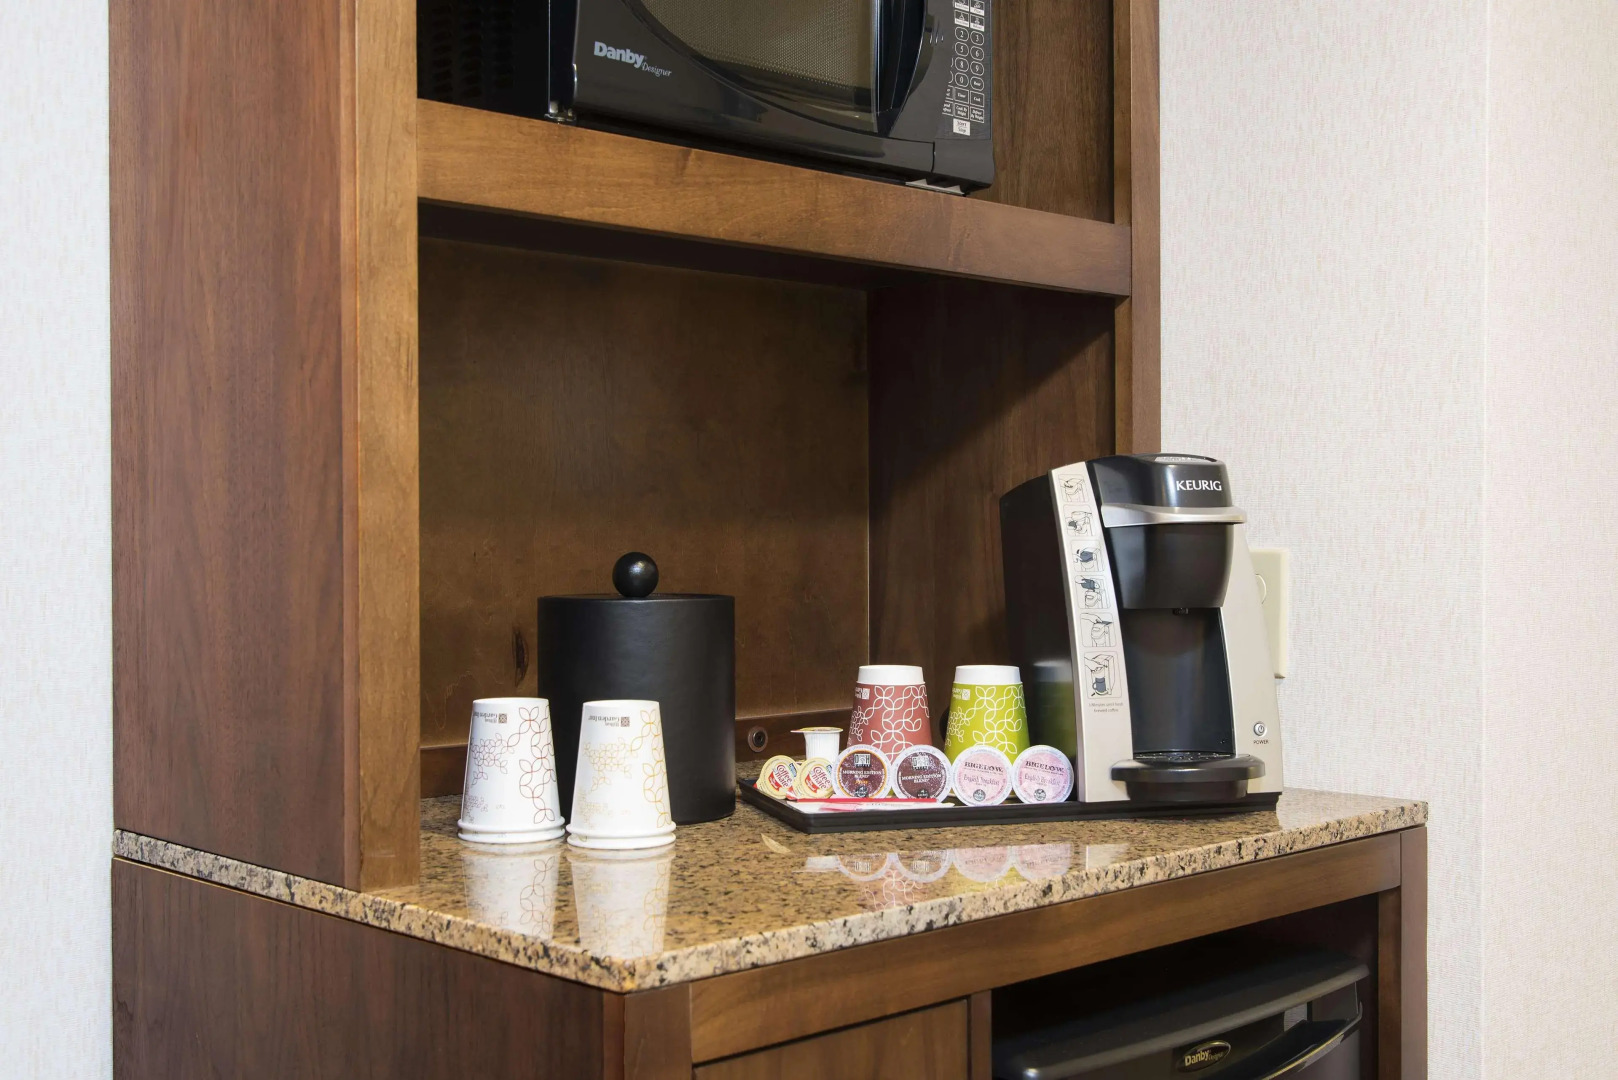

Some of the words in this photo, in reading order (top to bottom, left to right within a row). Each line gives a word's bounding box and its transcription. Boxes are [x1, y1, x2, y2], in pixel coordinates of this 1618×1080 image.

[594, 41, 644, 68] Danby
[642, 62, 672, 77] Designer
[1176, 480, 1222, 490] KEURIG
[776, 764, 792, 782] Coffee
[964, 761, 1002, 772] BIGELOW
[1026, 761, 1064, 772] BIGELOW
[775, 770, 788, 787] mate
[812, 774, 827, 788] mate
[813, 766, 830, 784] Coffee
[1185, 1050, 1210, 1066] Danby
